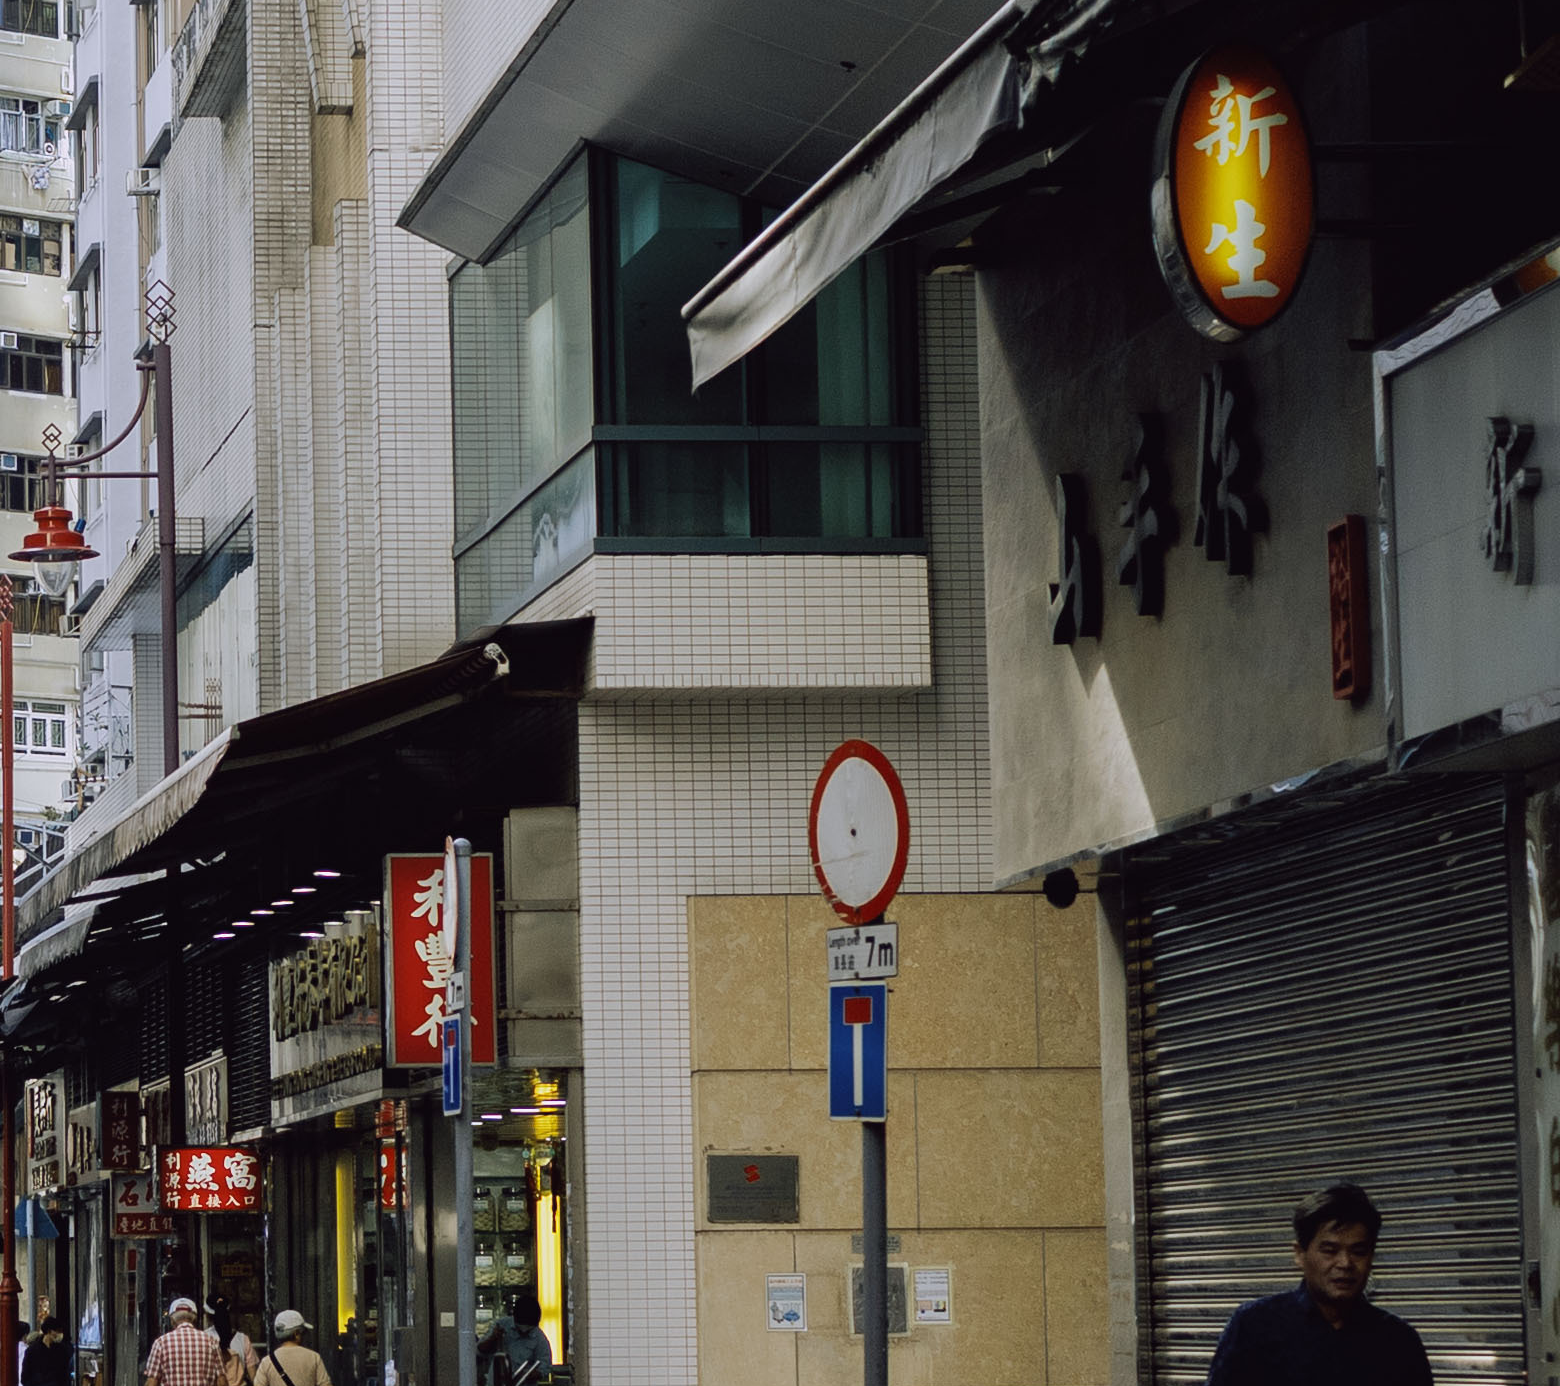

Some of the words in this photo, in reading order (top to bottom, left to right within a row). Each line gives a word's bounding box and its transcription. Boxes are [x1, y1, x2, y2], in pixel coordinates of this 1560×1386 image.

[1193, 73, 1288, 301] 新生
[165, 1152, 182, 1209] 利源行
[184, 1153, 258, 1191] 燕窩
[188, 1194, 256, 1209] 直接入口
